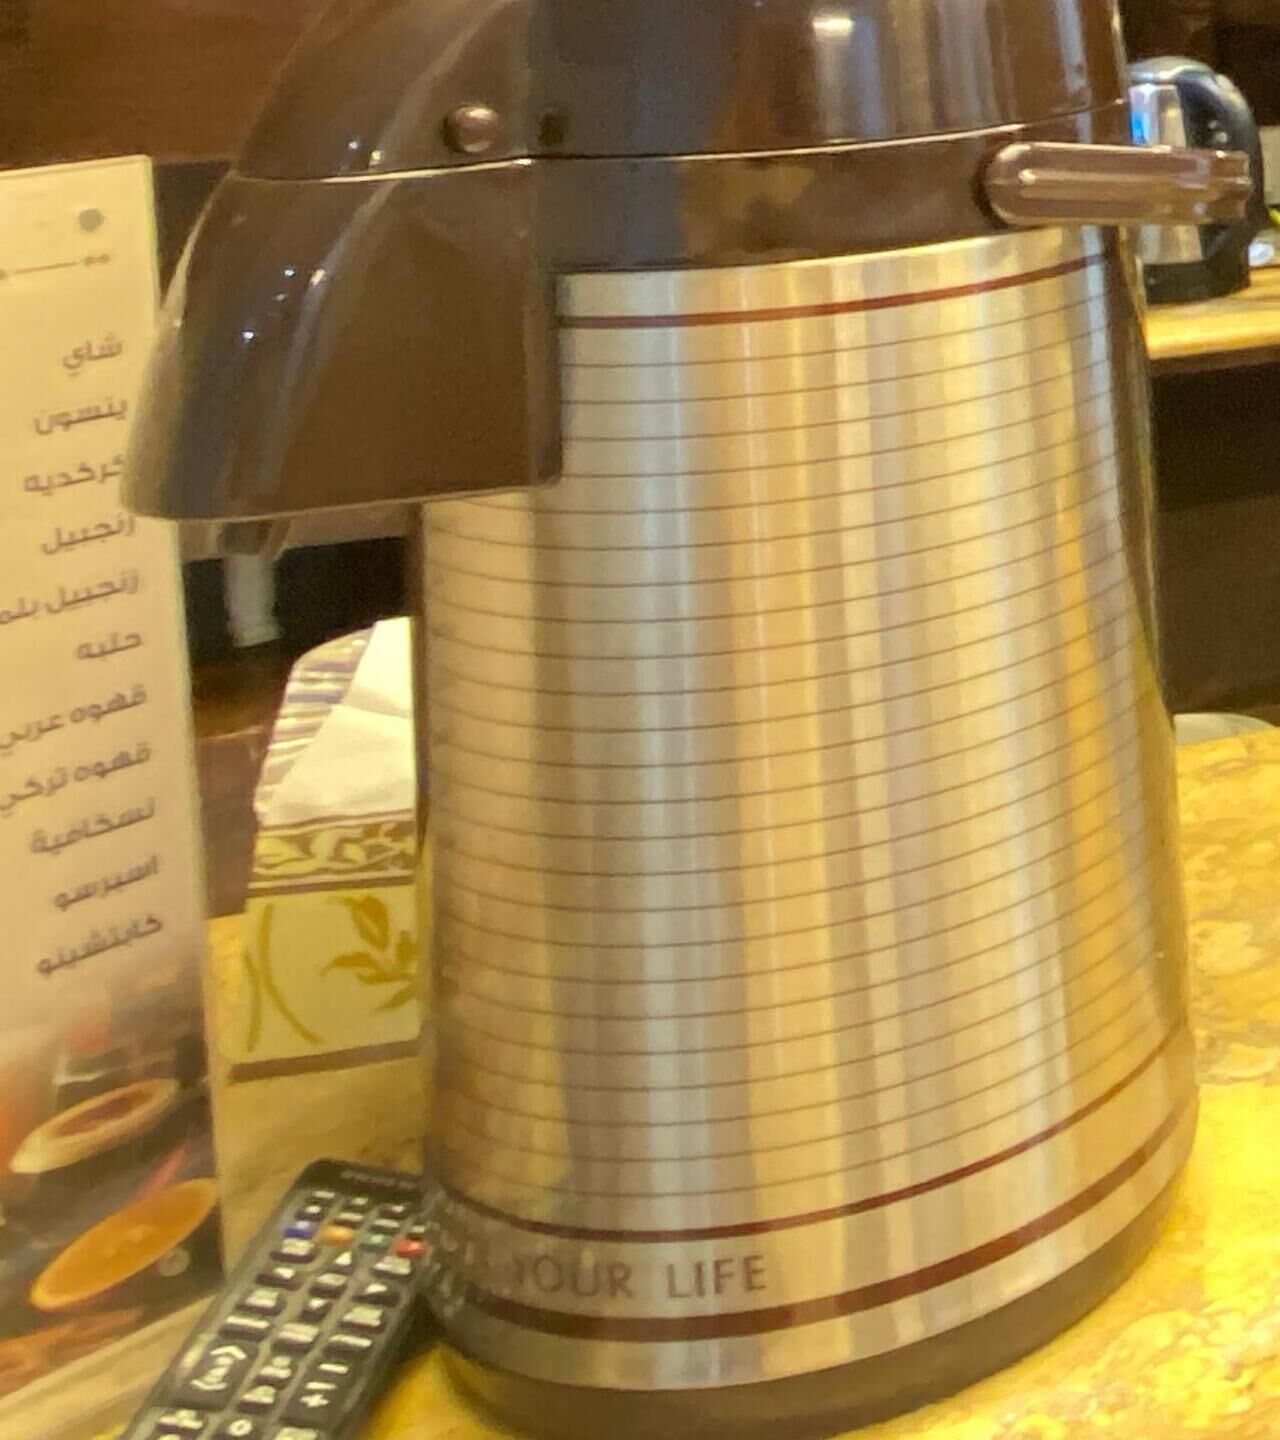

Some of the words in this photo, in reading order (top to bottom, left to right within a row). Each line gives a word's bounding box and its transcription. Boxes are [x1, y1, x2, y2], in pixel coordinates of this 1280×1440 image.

[62, 332, 124, 377] شاي
[33, 396, 128, 435] ينسون
[41, 510, 136, 555] زنجبيل
[46, 568, 140, 615] زنجبيل
[76, 632, 144, 660] حلبه
[69, 683, 147, 724] قهوه
[74, 741, 152, 782] قهوه
[666, 1253, 768, 1300] LIFE
